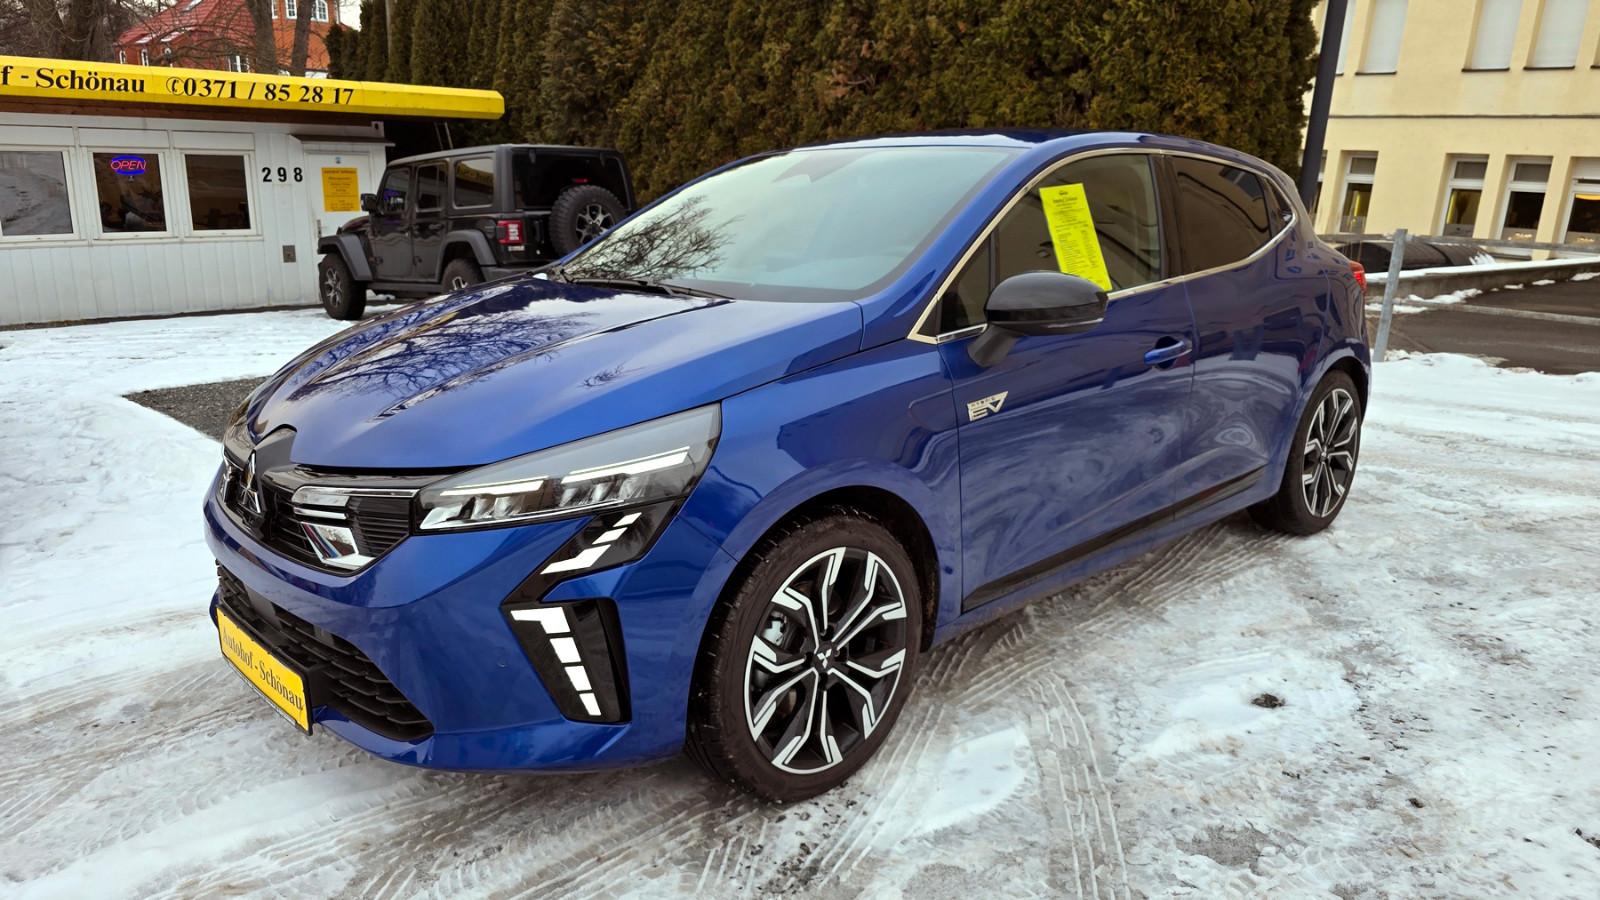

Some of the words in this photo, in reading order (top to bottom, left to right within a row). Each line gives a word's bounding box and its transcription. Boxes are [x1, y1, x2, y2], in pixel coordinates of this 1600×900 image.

[36, 67, 145, 92] Schönau
[184, 77, 237, 99] 0371
[248, 82, 256, 100] /
[264, 83, 290, 102] 85
[298, 85, 323, 103] 28
[332, 88, 354, 105] 17
[111, 160, 146, 170] OPEN
[223, 626, 253, 669] Autohof
[260, 660, 304, 711] Schönau
